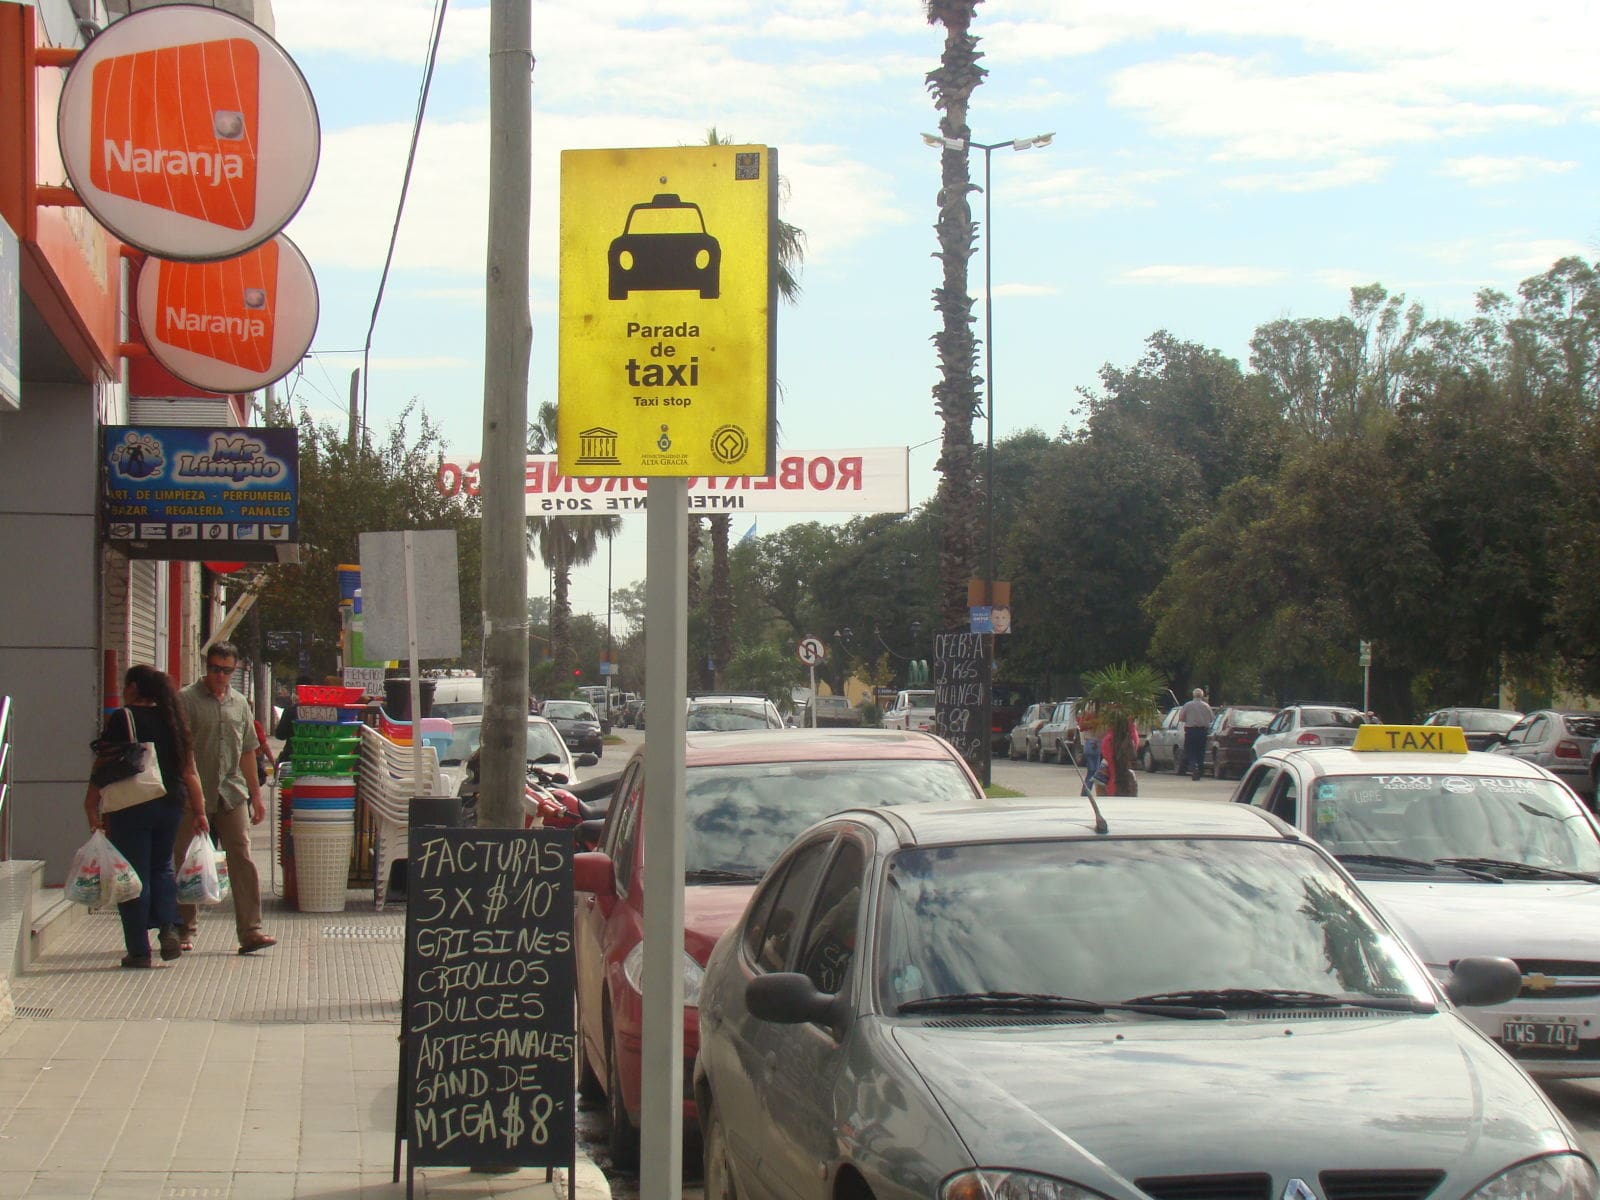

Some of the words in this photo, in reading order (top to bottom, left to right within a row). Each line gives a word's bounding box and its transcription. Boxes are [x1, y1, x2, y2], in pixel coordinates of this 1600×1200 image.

[104, 139, 244, 187] Naranja
[165, 306, 265, 342] Naranja
[627, 322, 700, 338] Parada
[650, 341, 676, 357] de
[625, 356, 699, 387] taxi
[633, 396, 659, 407] Taxi
[663, 396, 692, 408] stop
[211, 437, 262, 461] Mr
[581, 437, 617, 457] UNESCO
[178, 455, 281, 483] Limpio
[660, 458, 689, 466] GRACIA
[136, 490, 151, 500] DE
[154, 489, 206, 500] LIMPIEZA
[1385, 731, 1444, 750] TAXI
[1372, 776, 1433, 785] TAXI
[418, 838, 563, 886] FACTURAS
[416, 888, 446, 922] 3
[417, 927, 570, 962] GRISINES
[418, 960, 549, 997] CRIOLLOS
[411, 993, 545, 1032] DULCES
[1545, 1024, 1575, 1044] 747
[416, 1028, 574, 1079] ARTESANALES
[496, 1064, 542, 1092] DE
[414, 1099, 497, 1149] MIGA
